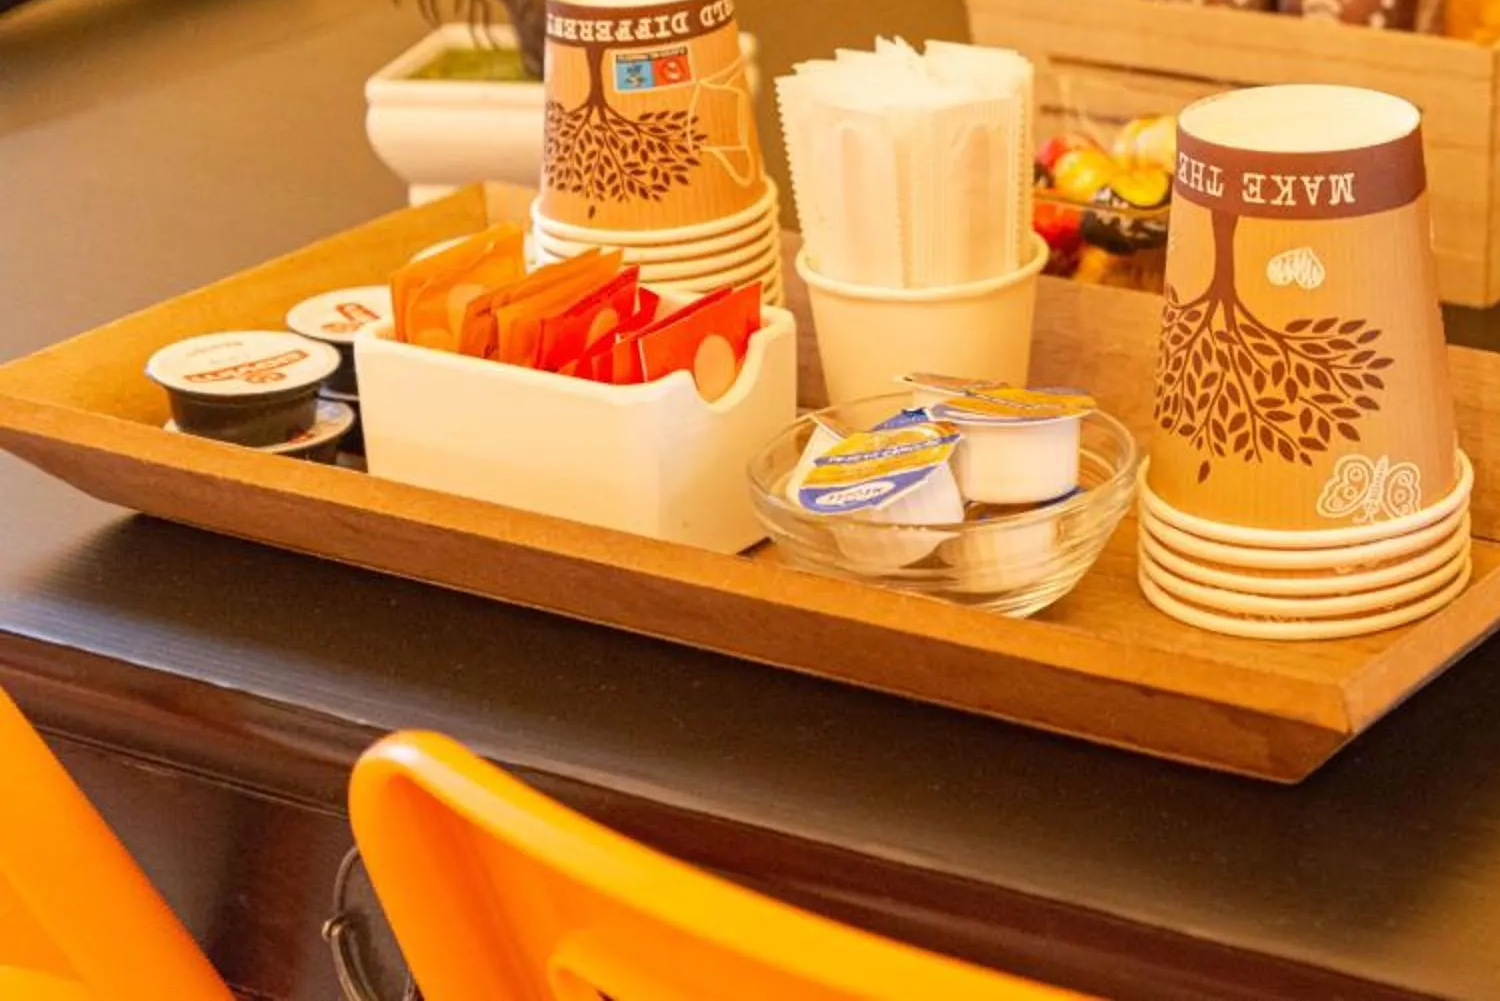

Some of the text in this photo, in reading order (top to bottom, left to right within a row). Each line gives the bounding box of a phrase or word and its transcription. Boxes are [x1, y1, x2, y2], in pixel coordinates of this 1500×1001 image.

[547, 11, 689, 42] DIFFEREN
[1178, 151, 1356, 206] MAKE THE
